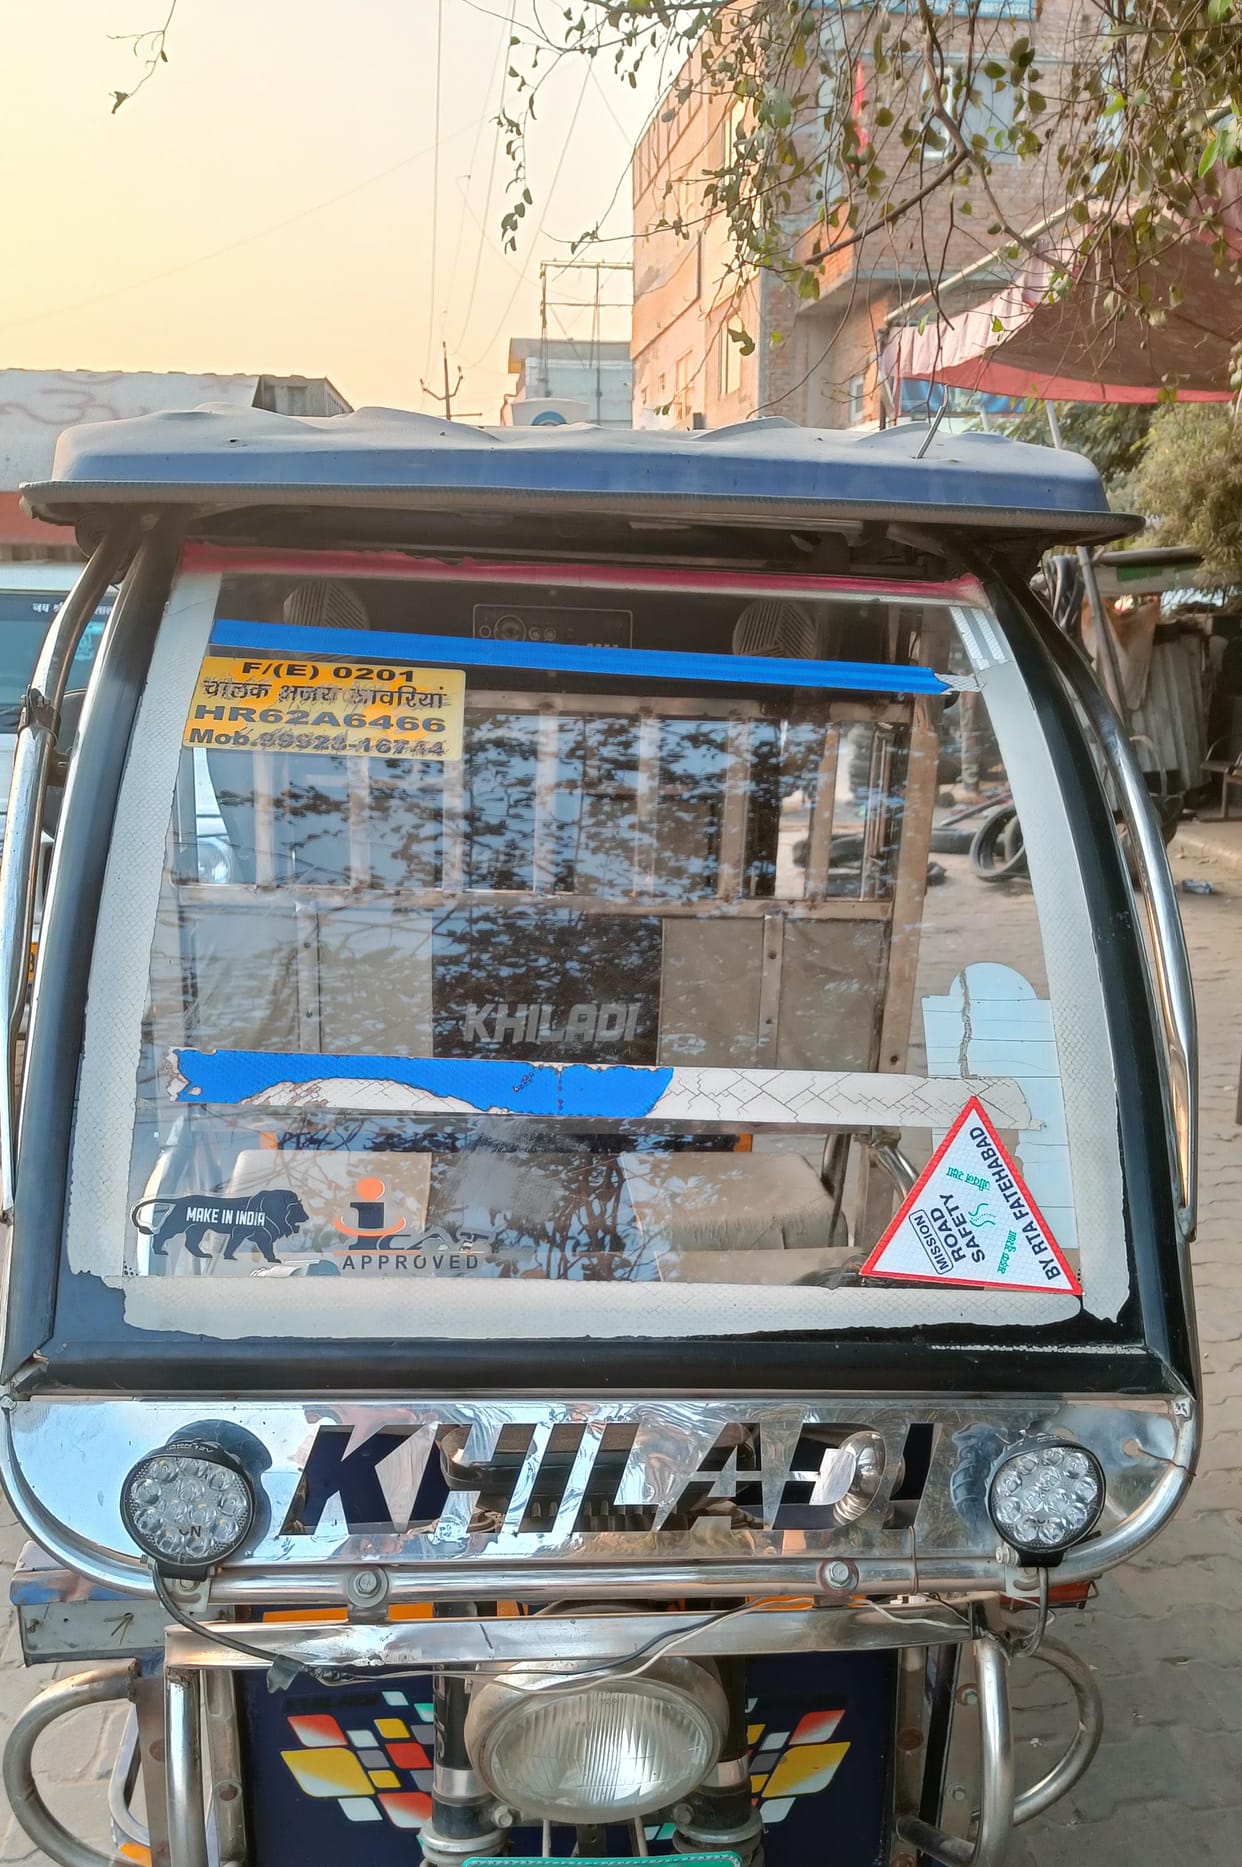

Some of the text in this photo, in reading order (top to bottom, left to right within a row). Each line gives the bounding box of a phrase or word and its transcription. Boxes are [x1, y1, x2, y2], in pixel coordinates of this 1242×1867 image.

[241, 661, 414, 683] F/(E) 0201
[194, 703, 447, 733] HR62A6466
[462, 1002, 643, 1044] KHILADI
[186, 1206, 265, 1227] MAKE IN INDIA
[939, 1193, 986, 1263] SAFETY
[969, 1126, 1061, 1281] BY RTA FATEHABAD
[914, 1214, 949, 1271] MISSION
[930, 1207, 967, 1263] ROAD
[342, 1255, 479, 1270] APPROVED
[275, 1421, 944, 1537] KHILADI
